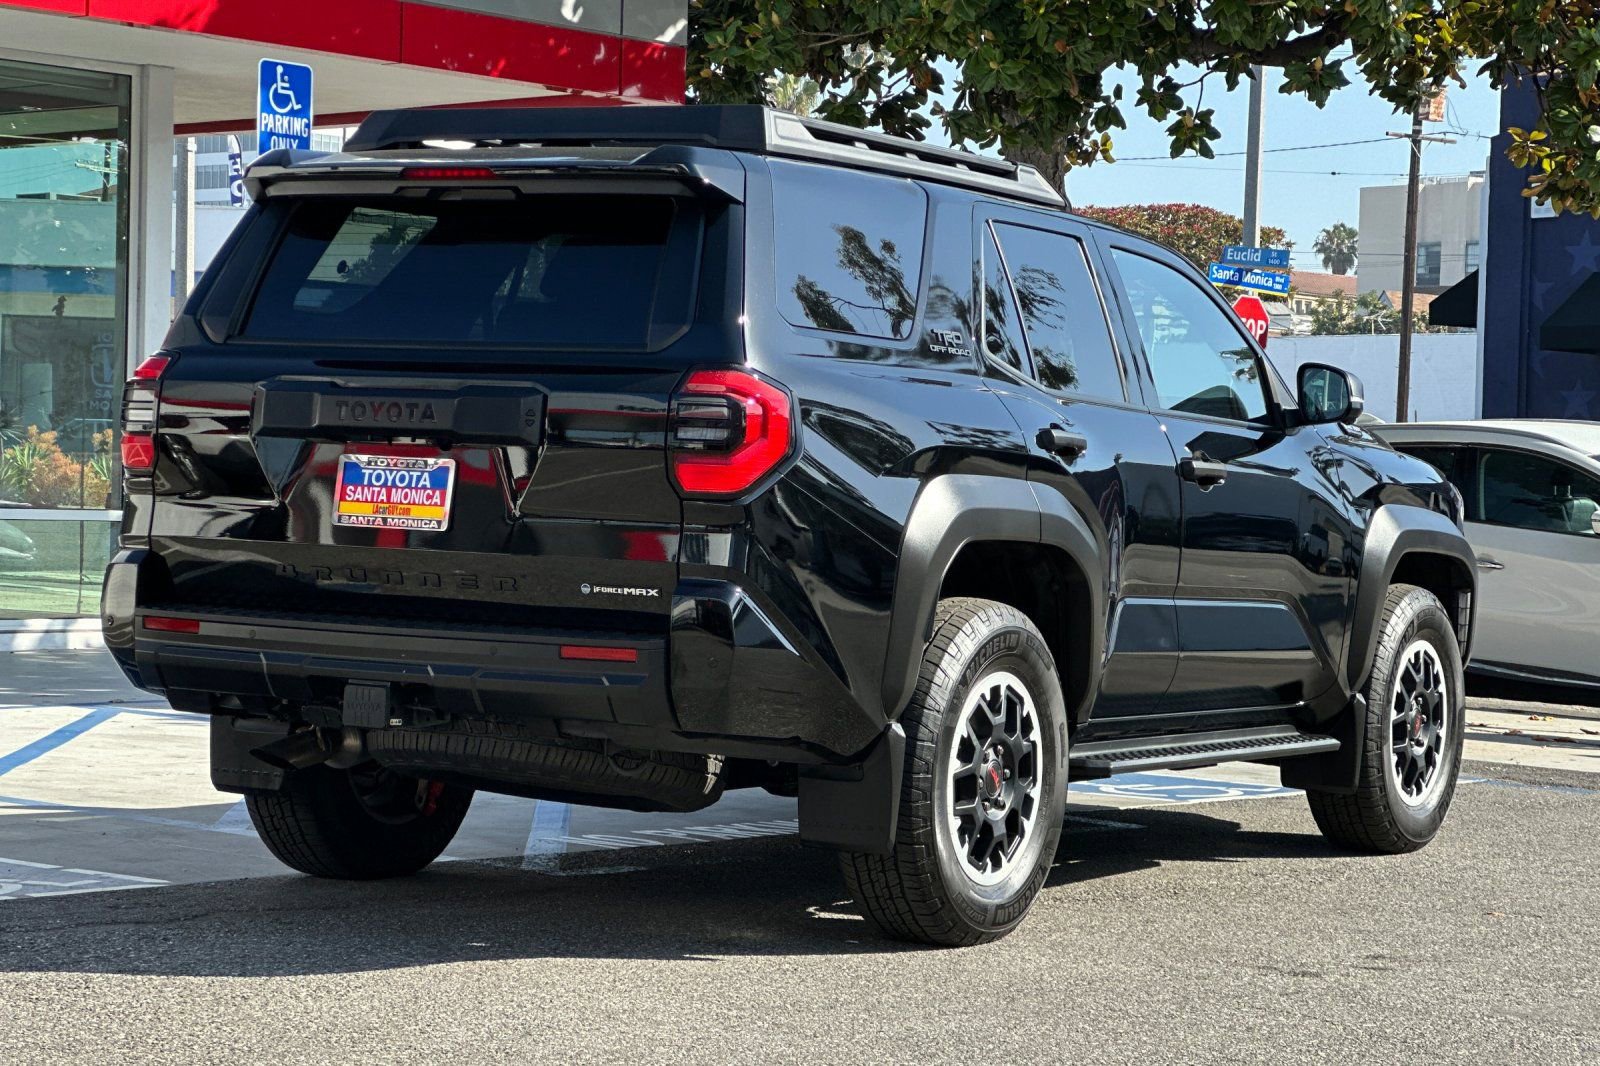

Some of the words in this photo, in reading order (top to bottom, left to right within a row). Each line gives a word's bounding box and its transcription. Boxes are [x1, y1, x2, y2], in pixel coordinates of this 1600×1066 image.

[261, 113, 309, 137] PARKING
[270, 136, 299, 150] ONLY
[1226, 248, 1262, 262] Euclid
[1212, 266, 1239, 281] Santa
[1241, 270, 1273, 287] Monica
[933, 328, 963, 347] TRD
[948, 347, 971, 356] ROAD
[336, 401, 436, 423] TOYOTA
[368, 457, 426, 469] TOYOTA
[361, 469, 431, 488] TOYOTA
[345, 486, 387, 503] SANTA
[390, 489, 441, 506] MONICA
[340, 515, 384, 526] SANTA
[387, 518, 439, 529] MONICA
[966, 633, 1019, 683] MICHELIN
[995, 867, 1044, 923] MICHELIN
